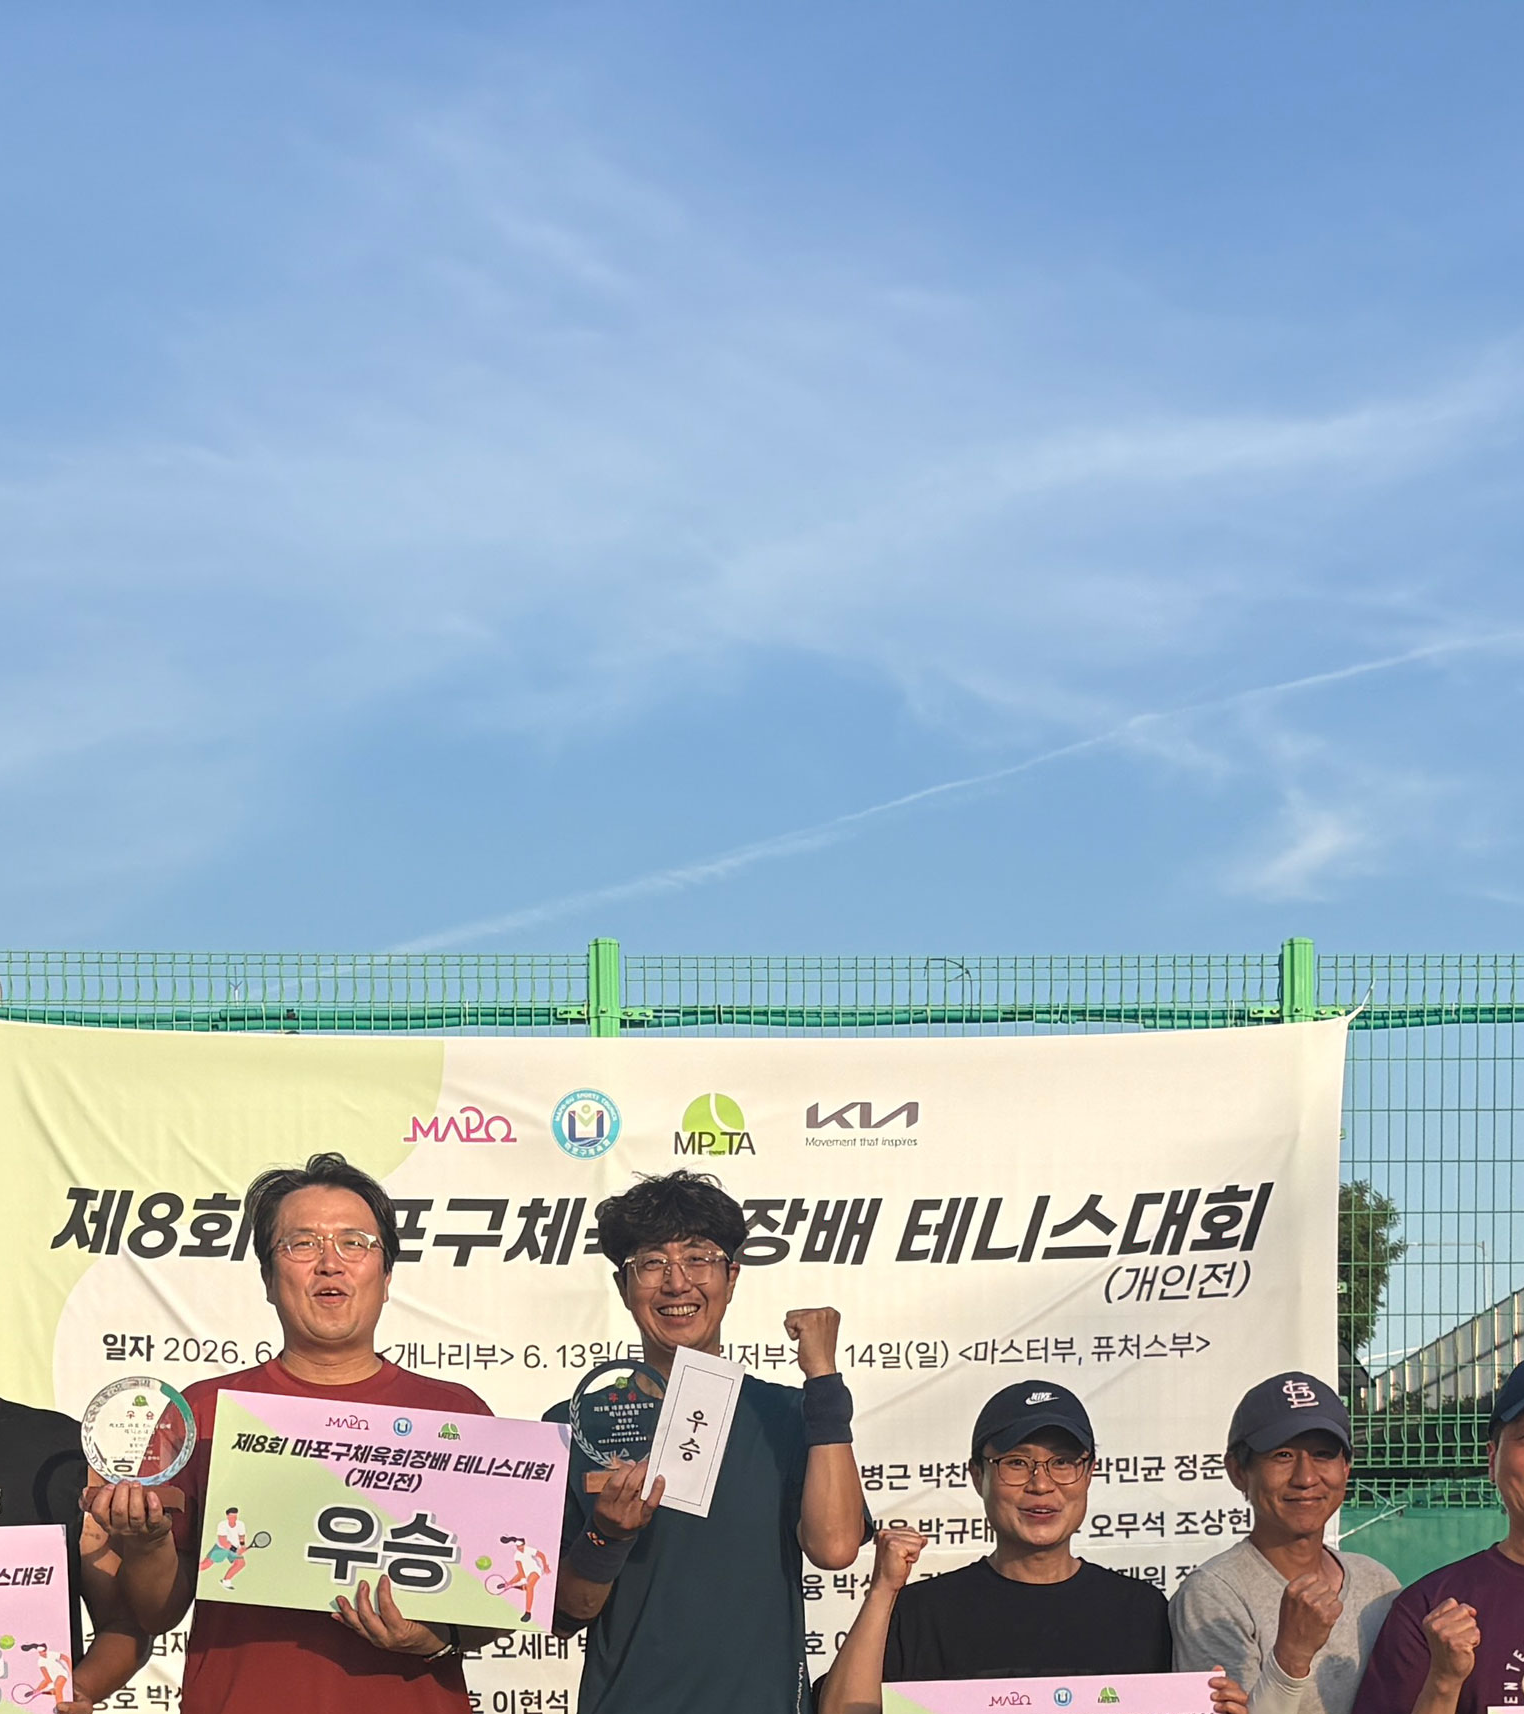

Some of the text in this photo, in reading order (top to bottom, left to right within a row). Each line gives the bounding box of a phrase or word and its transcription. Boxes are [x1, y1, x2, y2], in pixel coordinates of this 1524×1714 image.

[805, 1136, 918, 1149] Movement that inspires
[51, 1186, 255, 1262] 제8회
[895, 1181, 1275, 1265] 테니스대회
[1103, 1260, 1251, 1304] (개인전)
[102, 1333, 155, 1363] 일자
[164, 1336, 246, 1365] 2026.
[379, 1342, 515, 1370] <개나리부>
[524, 1345, 548, 1369] 6.
[845, 1340, 949, 1370] 14일(일)
[958, 1336, 1083, 1367] <마스터부,
[1091, 1332, 1211, 1364] 퓨처스부>
[1030, 1392, 1052, 1401] NIKE
[231, 1432, 555, 1483] 제8회 마포구체육회장배 테니스대회
[344, 1467, 423, 1493] (개인전)
[1089, 1511, 1165, 1538] 오무석
[1175, 1507, 1252, 1536] 조상현
[307, 1506, 454, 1588] 우승
[491, 1633, 569, 1660] 오세태
